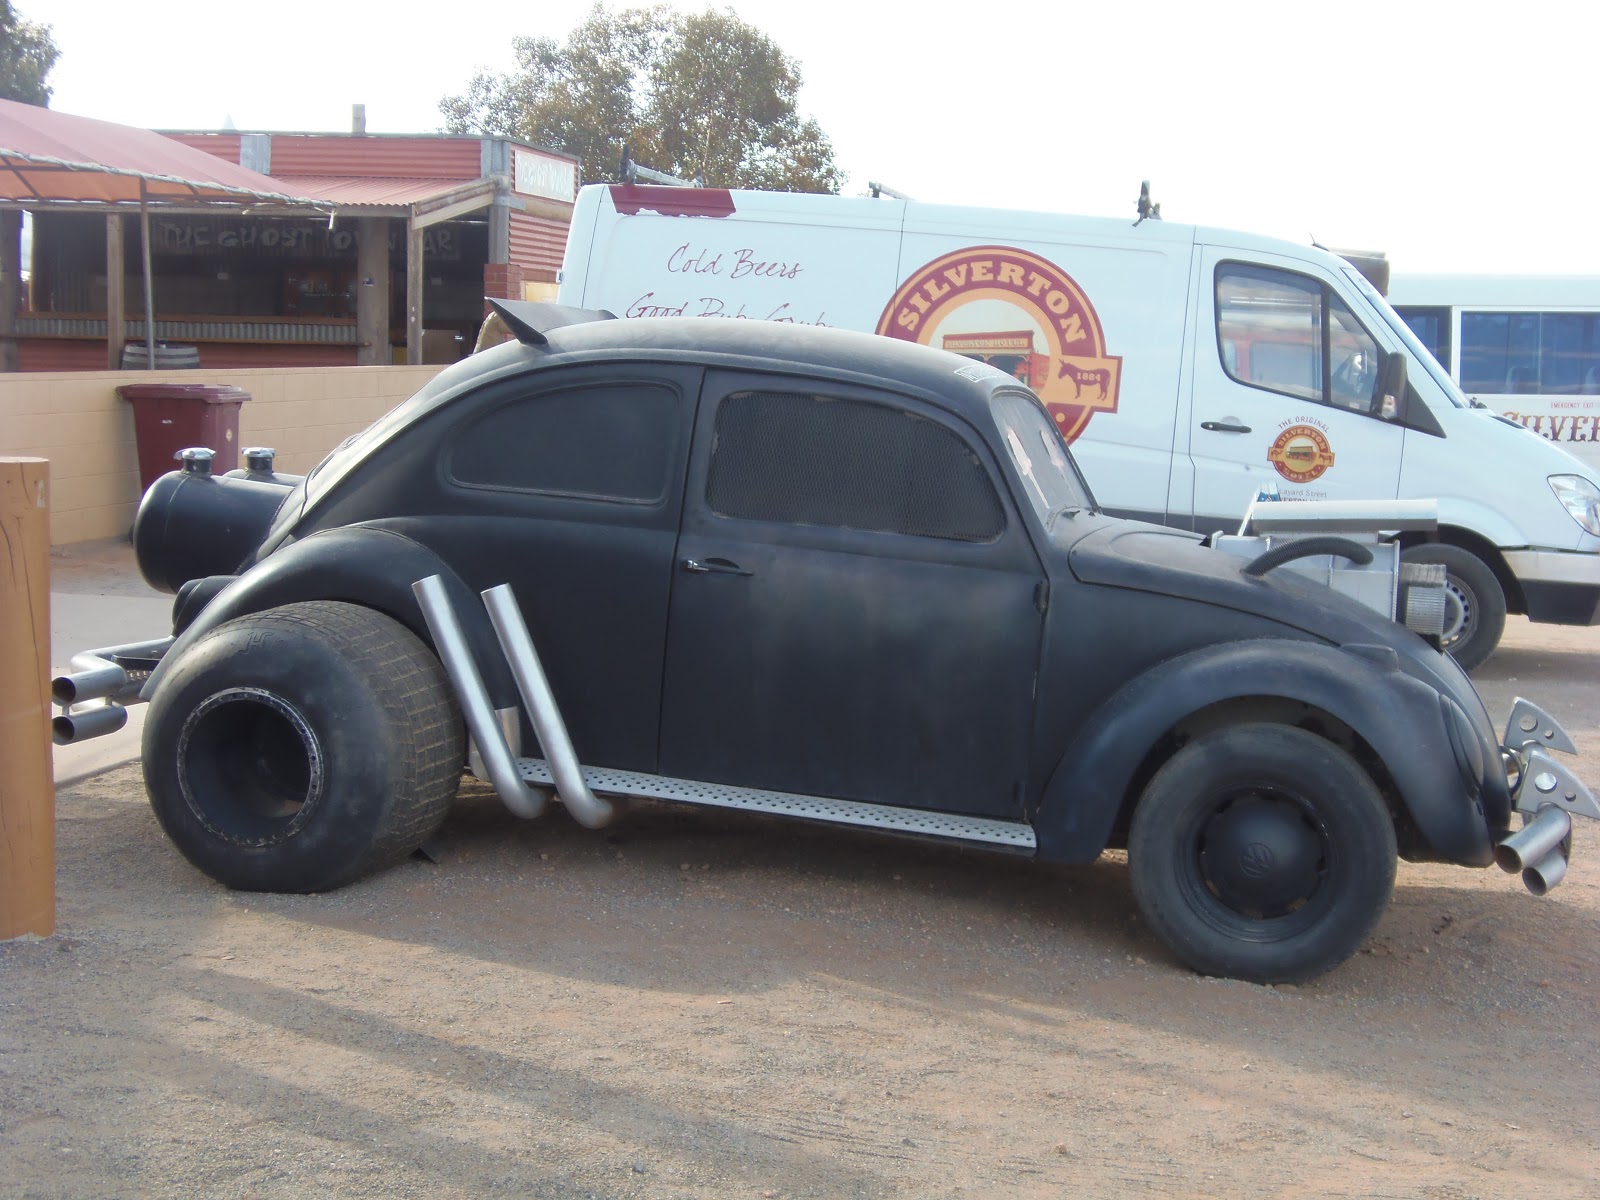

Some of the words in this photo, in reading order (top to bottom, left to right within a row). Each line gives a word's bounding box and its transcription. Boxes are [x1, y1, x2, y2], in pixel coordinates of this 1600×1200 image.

[159, 223, 210, 248] THE
[217, 226, 312, 248] GHOST
[320, 226, 398, 251] TON
[667, 242, 724, 275] Cold
[730, 248, 805, 279] Beers
[897, 260, 1087, 343] SILVERTON
[1278, 417, 1294, 429] THE
[1295, 415, 1330, 434] ORIGINAL
[1278, 427, 1327, 450] SILVERTON
[1305, 490, 1327, 498] Street
